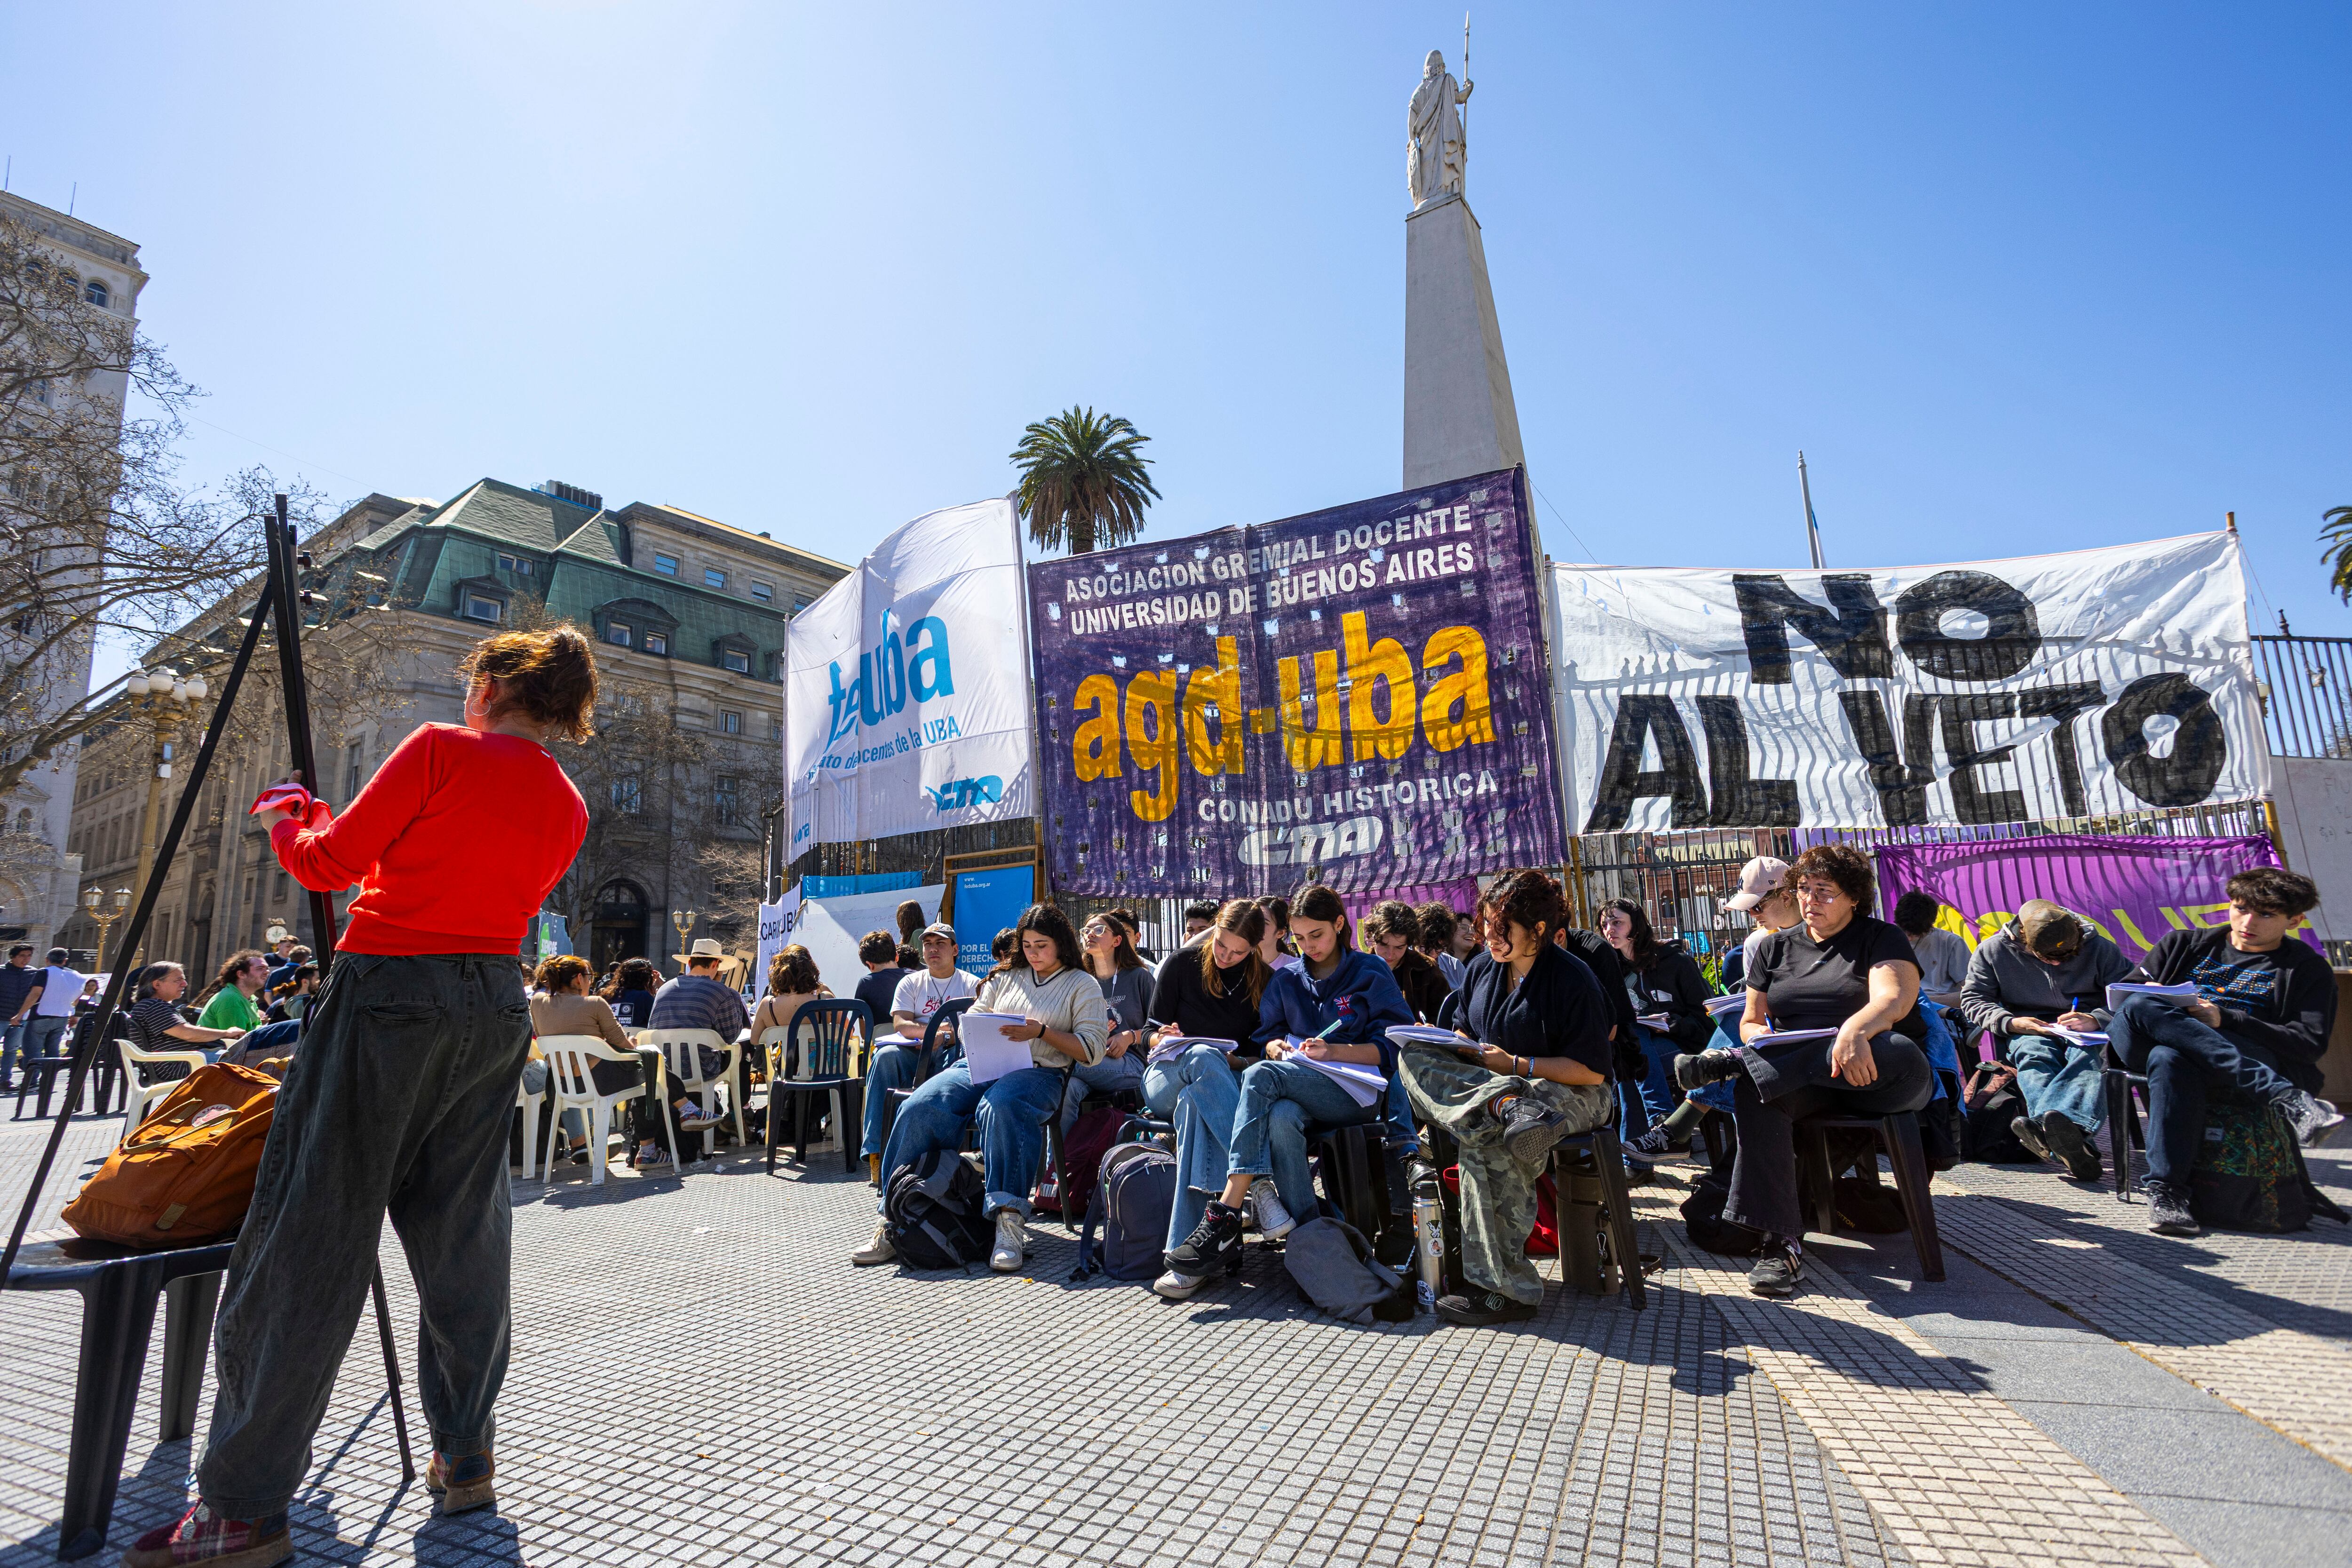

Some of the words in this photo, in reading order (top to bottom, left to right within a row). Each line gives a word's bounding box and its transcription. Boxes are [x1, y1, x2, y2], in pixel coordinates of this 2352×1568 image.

[1066, 561, 1205, 604] ASOCIACION
[1215, 535, 1326, 582] GREMIAL
[1335, 504, 1472, 555] DOCENTE
[1070, 591, 1220, 635] UNIVERSIDAD
[1230, 584, 1258, 615] DE
[1266, 557, 1377, 608] BUENOS
[1386, 542, 1474, 585] AIRES
[1732, 570, 2041, 685] NO
[896, 732, 909, 753] de
[908, 727, 923, 748] la
[923, 715, 961, 744] UBA
[1073, 610, 1497, 821] agd-uba
[1583, 694, 1800, 834] AL
[1839, 672, 2226, 827] VETO
[1198, 795, 1312, 824] CONADU
[1324, 769, 1498, 817] HISTORICA
[961, 944, 977, 953] POR
